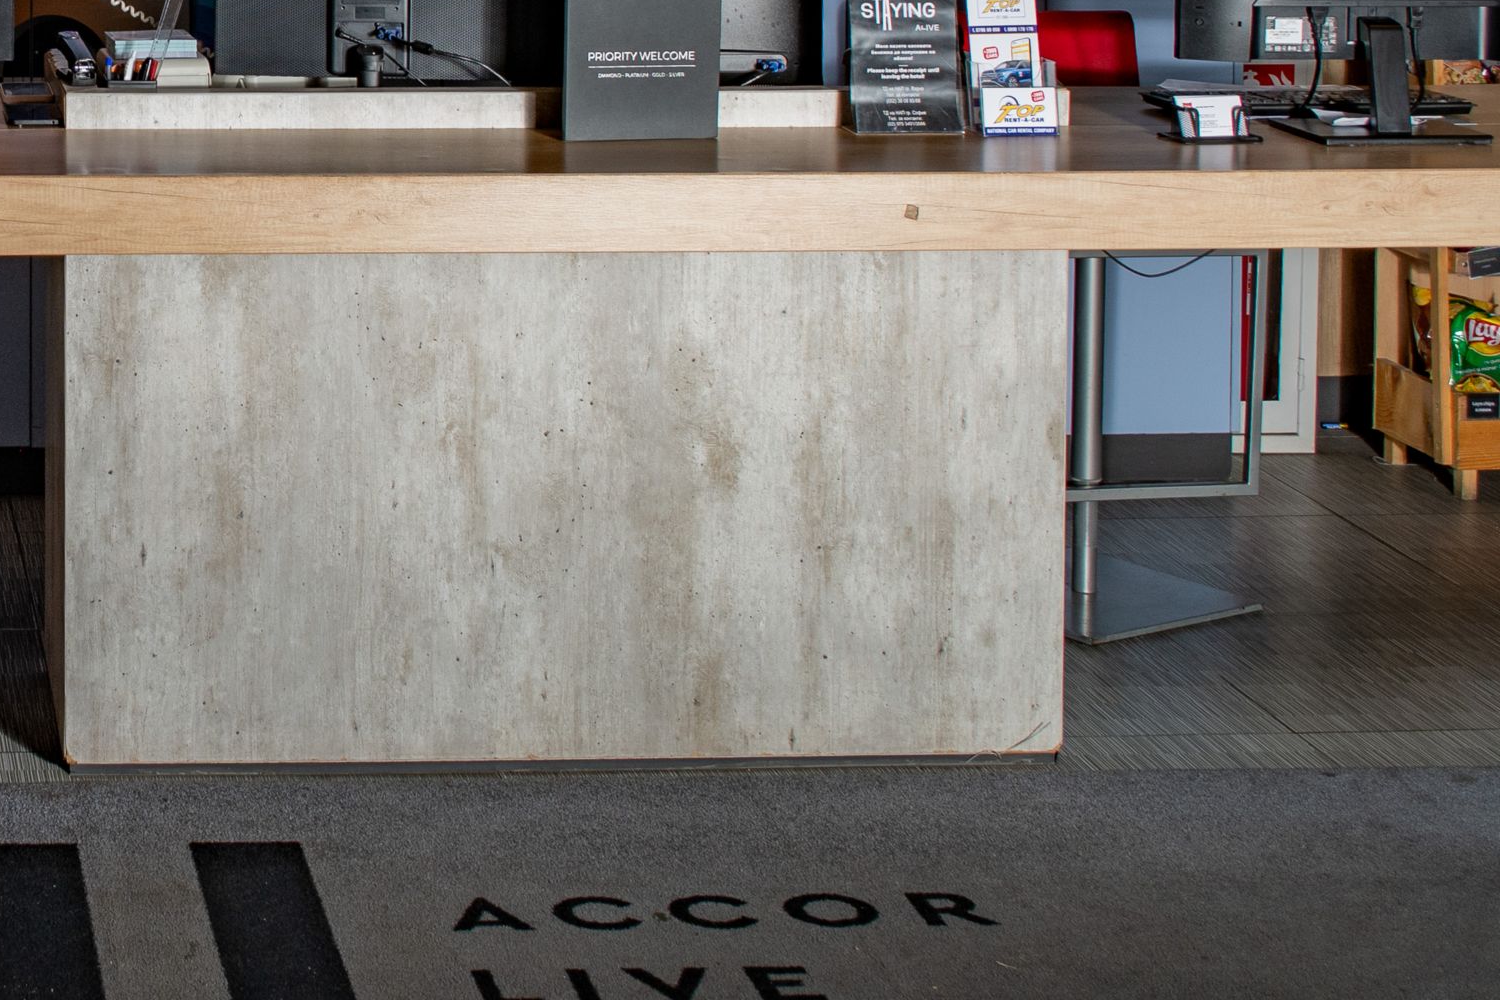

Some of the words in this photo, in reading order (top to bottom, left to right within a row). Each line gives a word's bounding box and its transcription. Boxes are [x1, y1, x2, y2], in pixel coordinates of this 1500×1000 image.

[915, 24, 940, 32] ALIVE
[588, 51, 638, 61] PRIORITY
[639, 50, 695, 61] WELCOME
[994, 104, 1045, 124] TOP
[453, 892, 1001, 932] ACCOR
[470, 965, 828, 1000] LIVE
